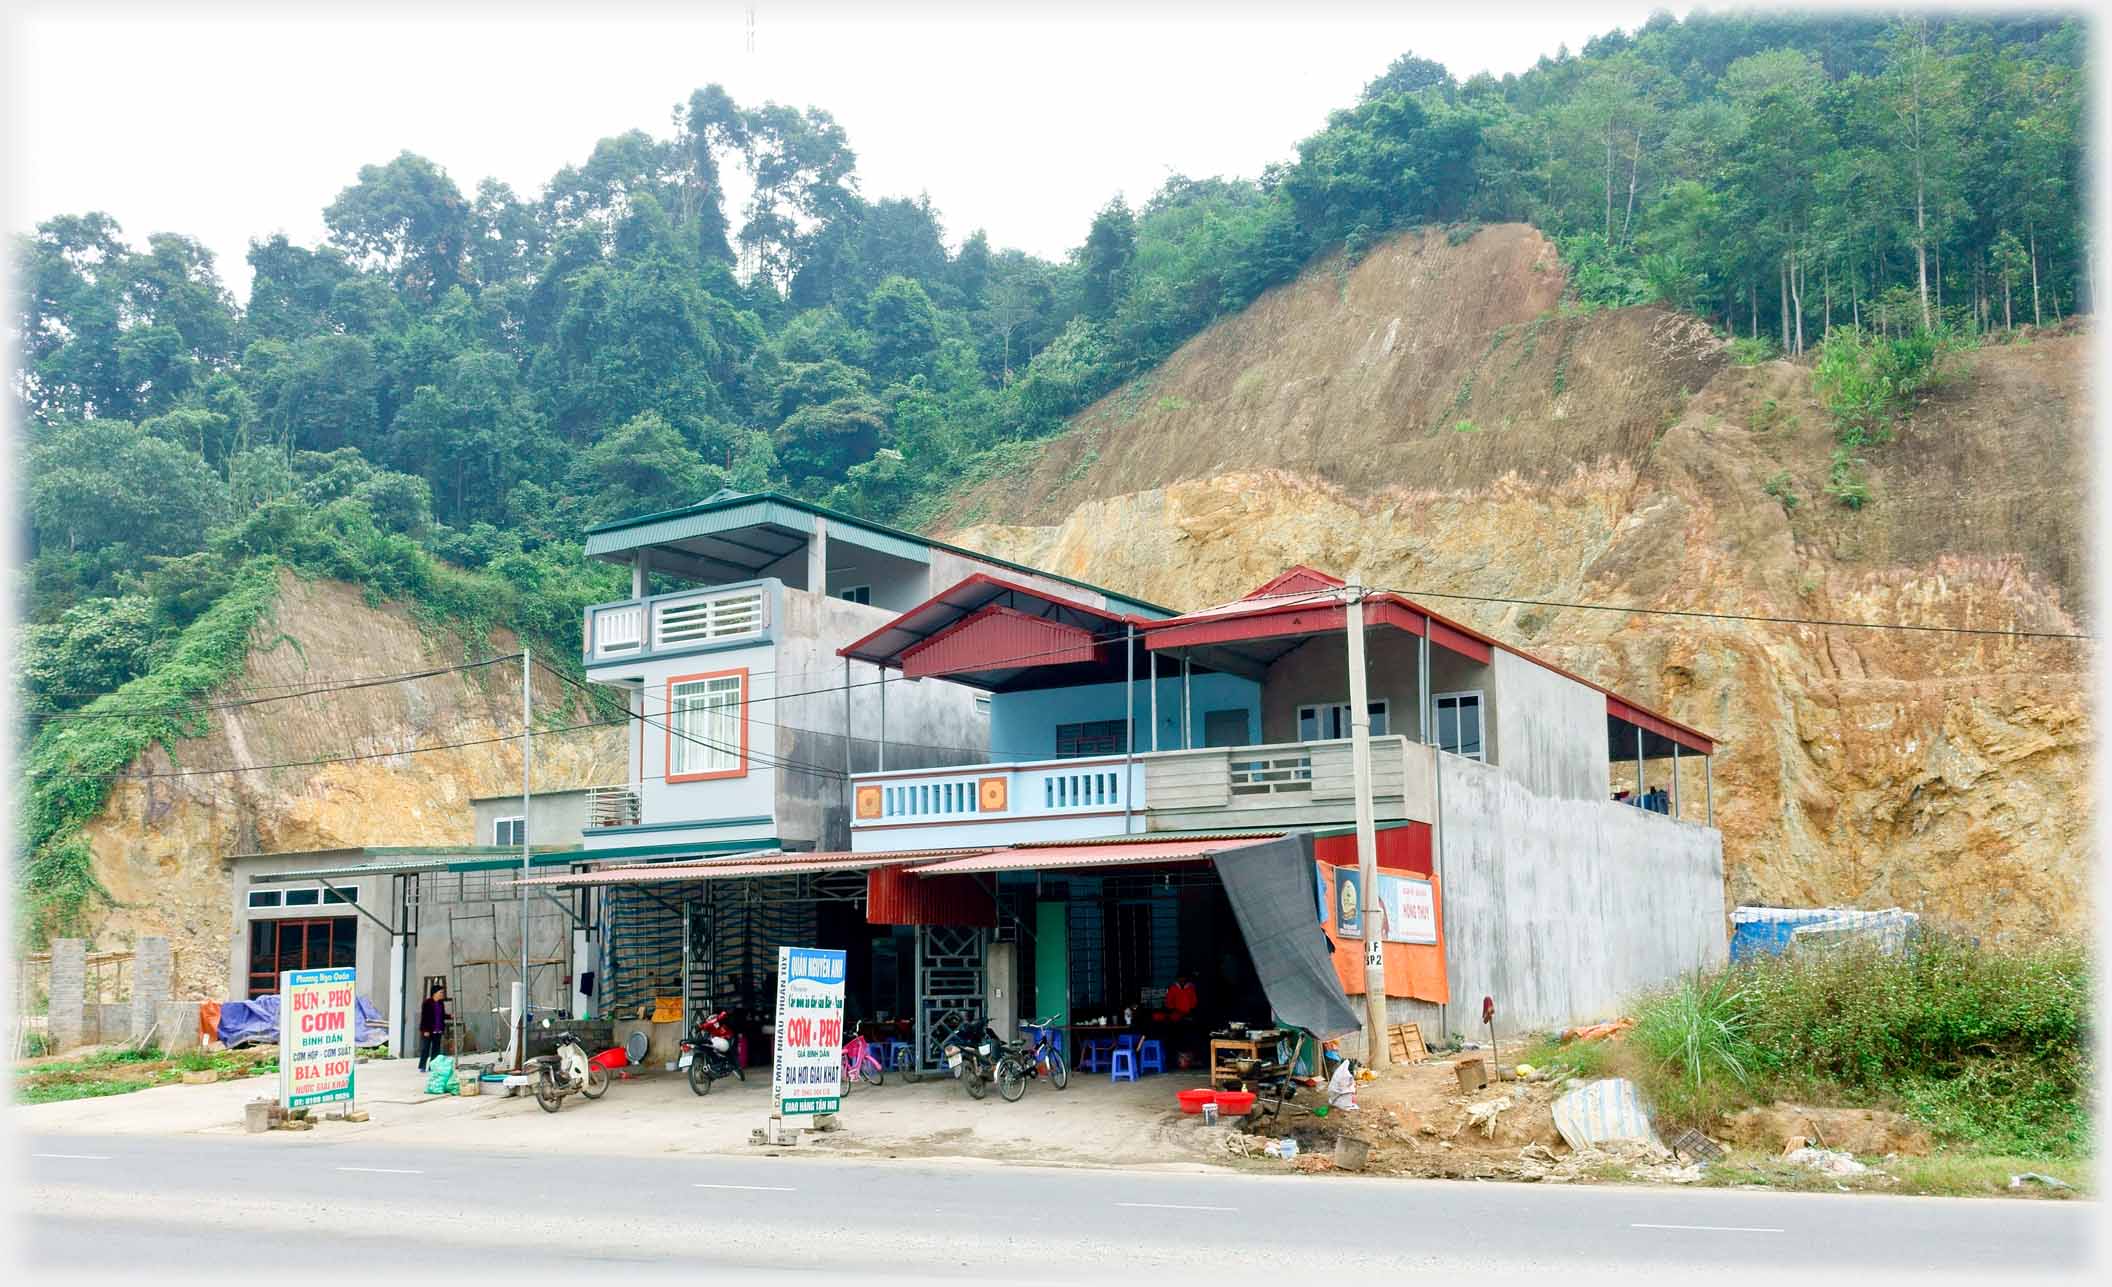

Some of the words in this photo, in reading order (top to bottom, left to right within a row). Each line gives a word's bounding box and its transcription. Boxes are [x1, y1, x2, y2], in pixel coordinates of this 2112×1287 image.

[293, 987, 319, 1011] BÚN
[328, 982, 353, 1008] PHỞ
[302, 1011, 345, 1033] CƠM
[787, 1016, 811, 1047] CƠM
[819, 1008, 842, 1047] PHỞ
[295, 1064, 320, 1081] BIA
[325, 1060, 350, 1077] HƠI
[785, 1066, 797, 1085] BIA
